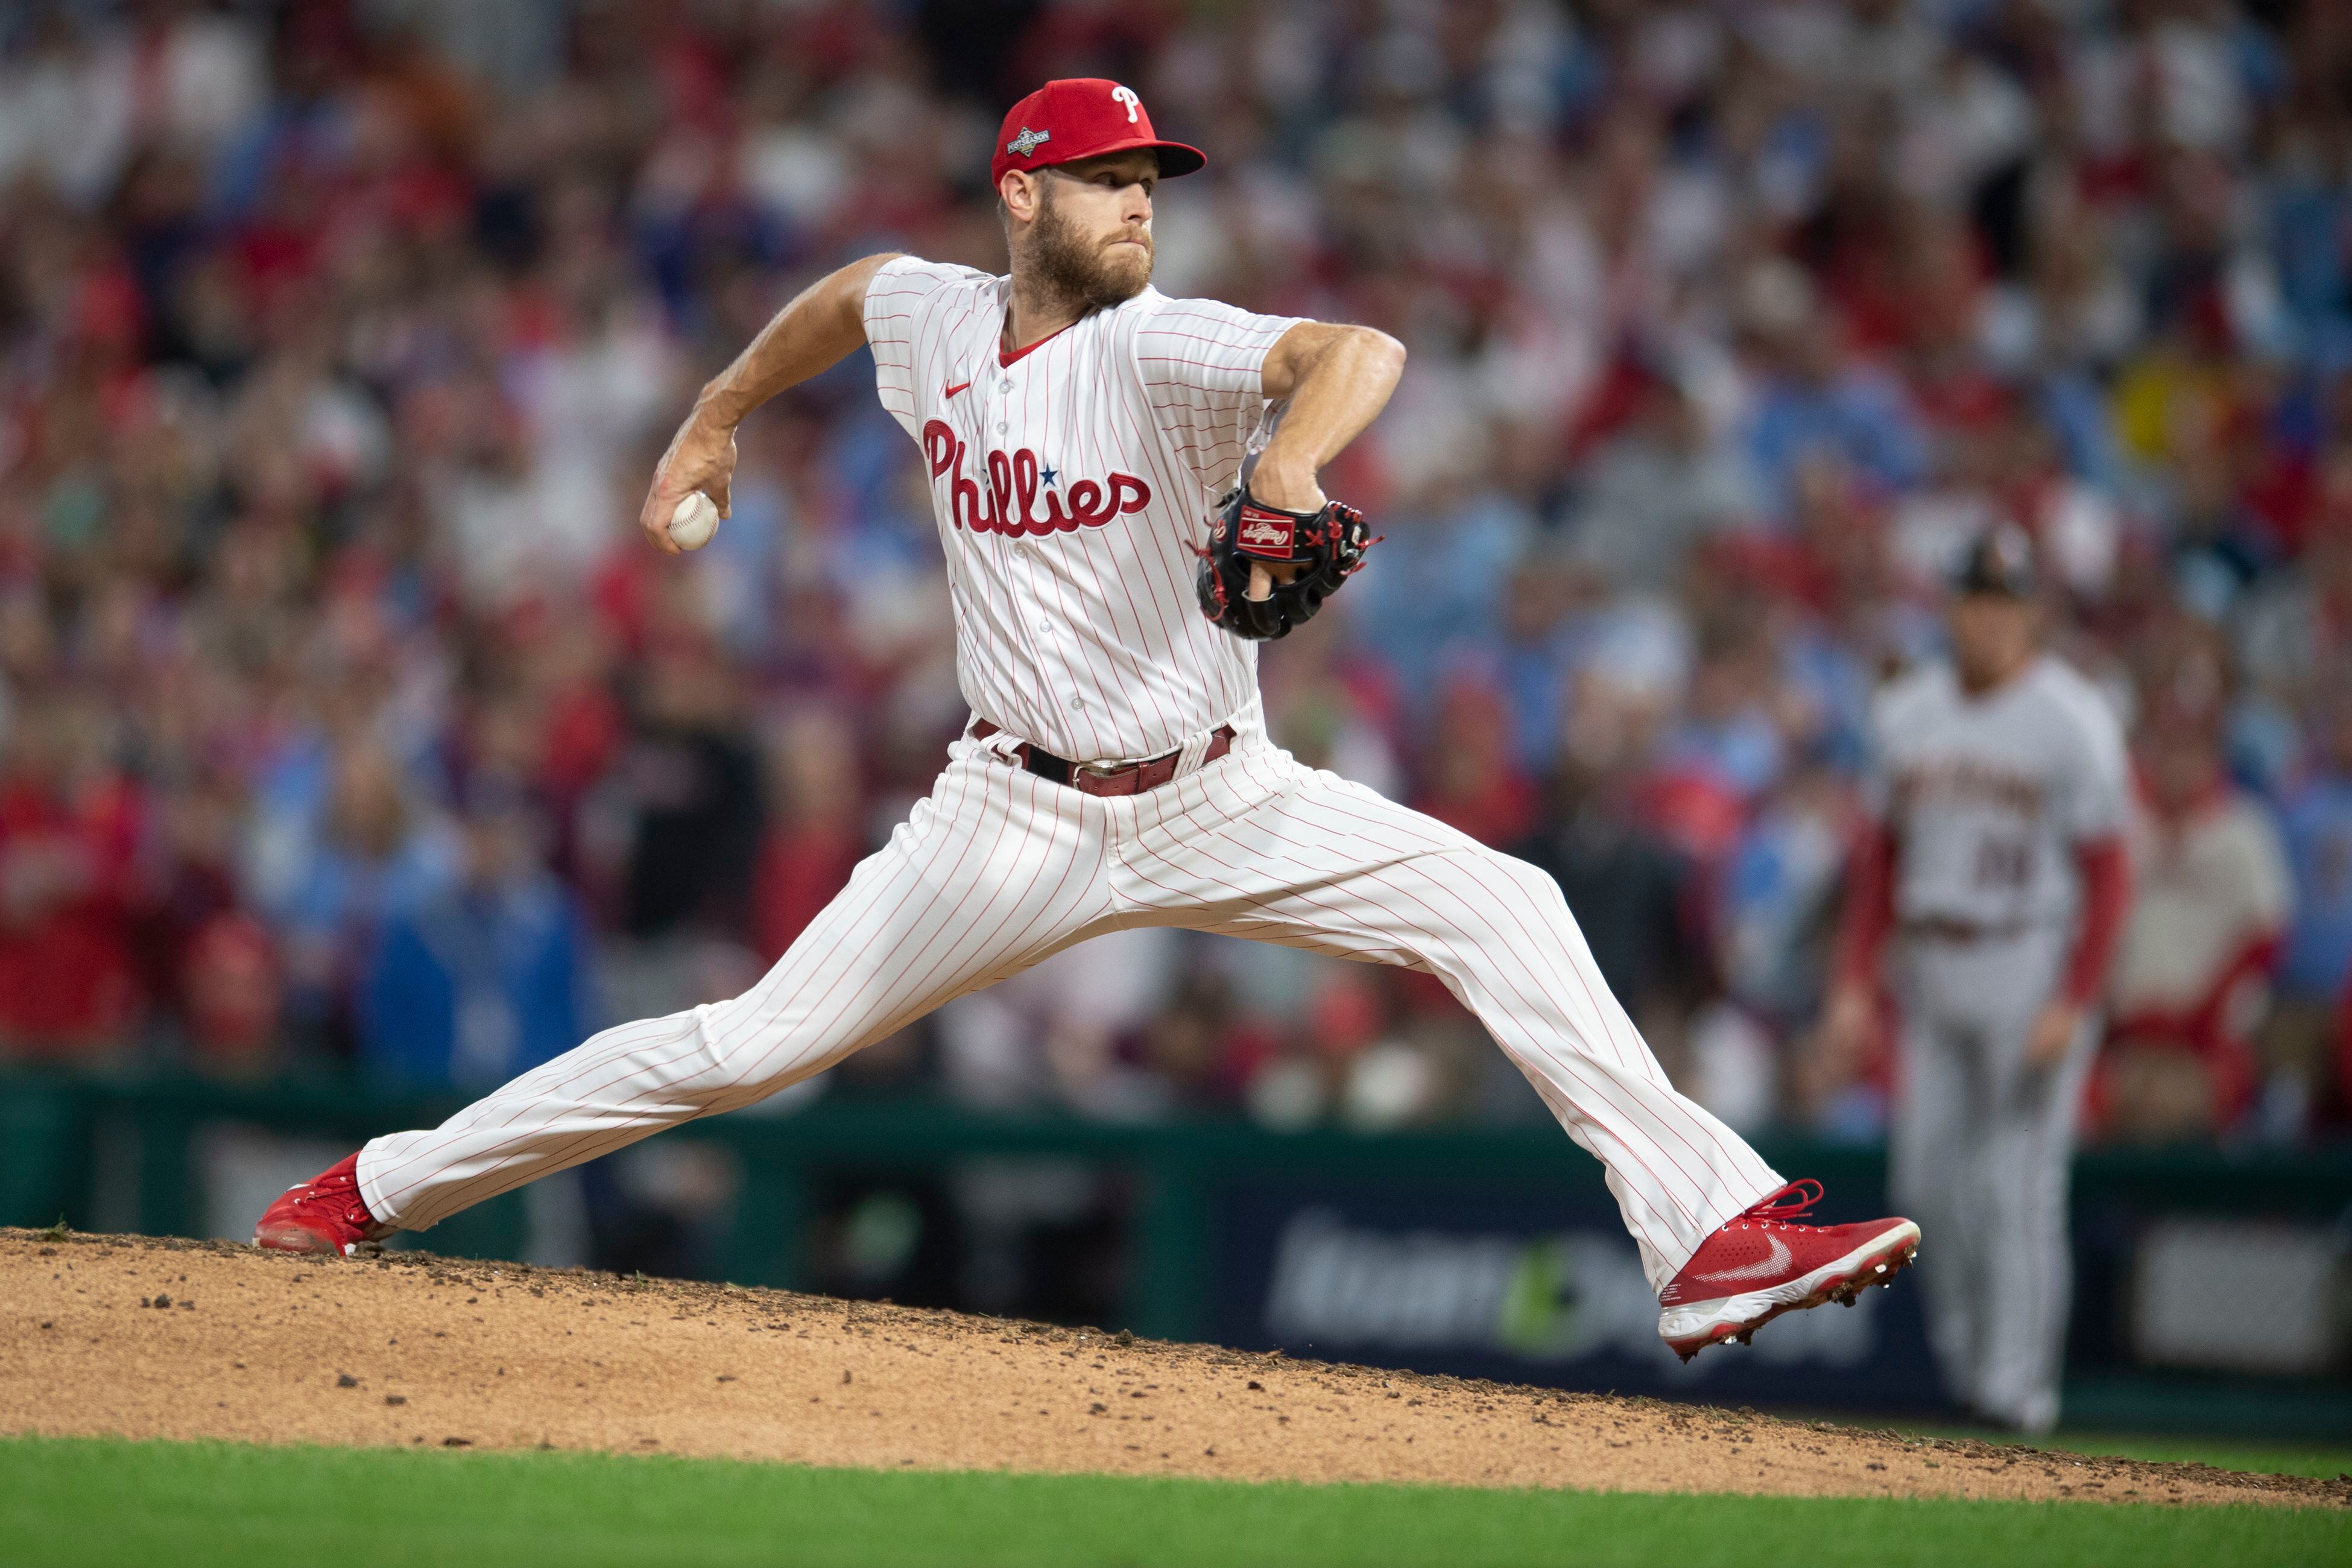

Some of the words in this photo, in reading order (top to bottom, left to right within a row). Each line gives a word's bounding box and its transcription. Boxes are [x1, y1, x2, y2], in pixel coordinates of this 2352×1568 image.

[1111, 86, 1139, 123] P
[1008, 131, 1049, 153] POSTSEASON
[923, 419, 1151, 538] Phillies
[1242, 523, 1289, 545] Rawlings
